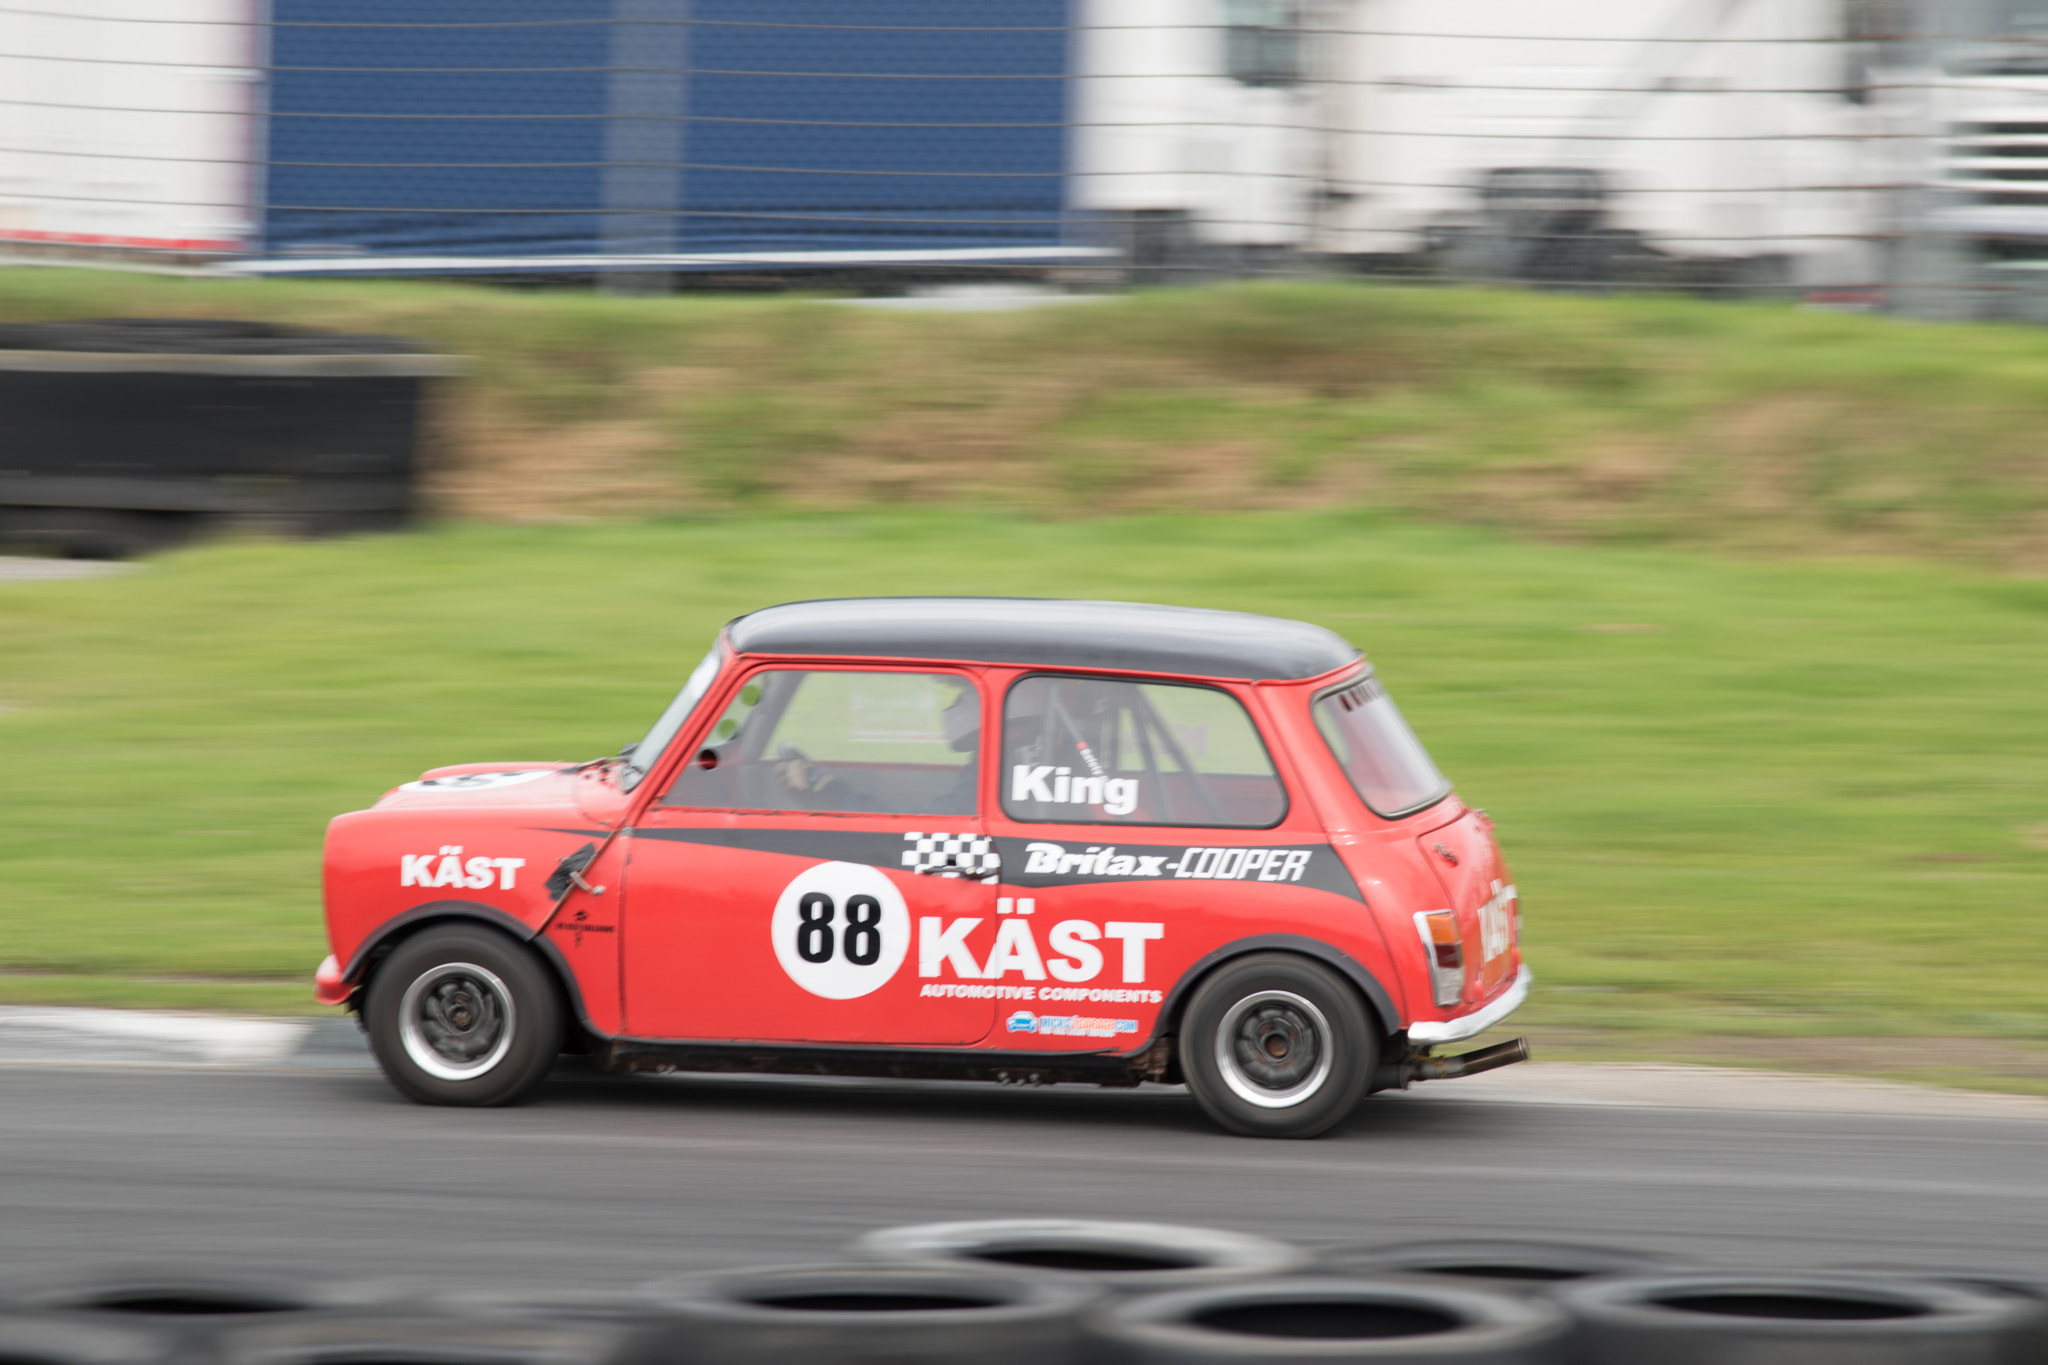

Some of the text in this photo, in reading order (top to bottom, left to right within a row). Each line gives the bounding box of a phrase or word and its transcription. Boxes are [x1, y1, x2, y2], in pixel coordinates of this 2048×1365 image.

[1012, 765, 1139, 815] King
[401, 845, 526, 890] KÄST
[1024, 843, 1313, 881] Britax-COOPER
[797, 891, 881, 966] 88
[919, 897, 1165, 983] KÄST
[920, 984, 1163, 1003] AUTOMOTIVE COMPONENTS
